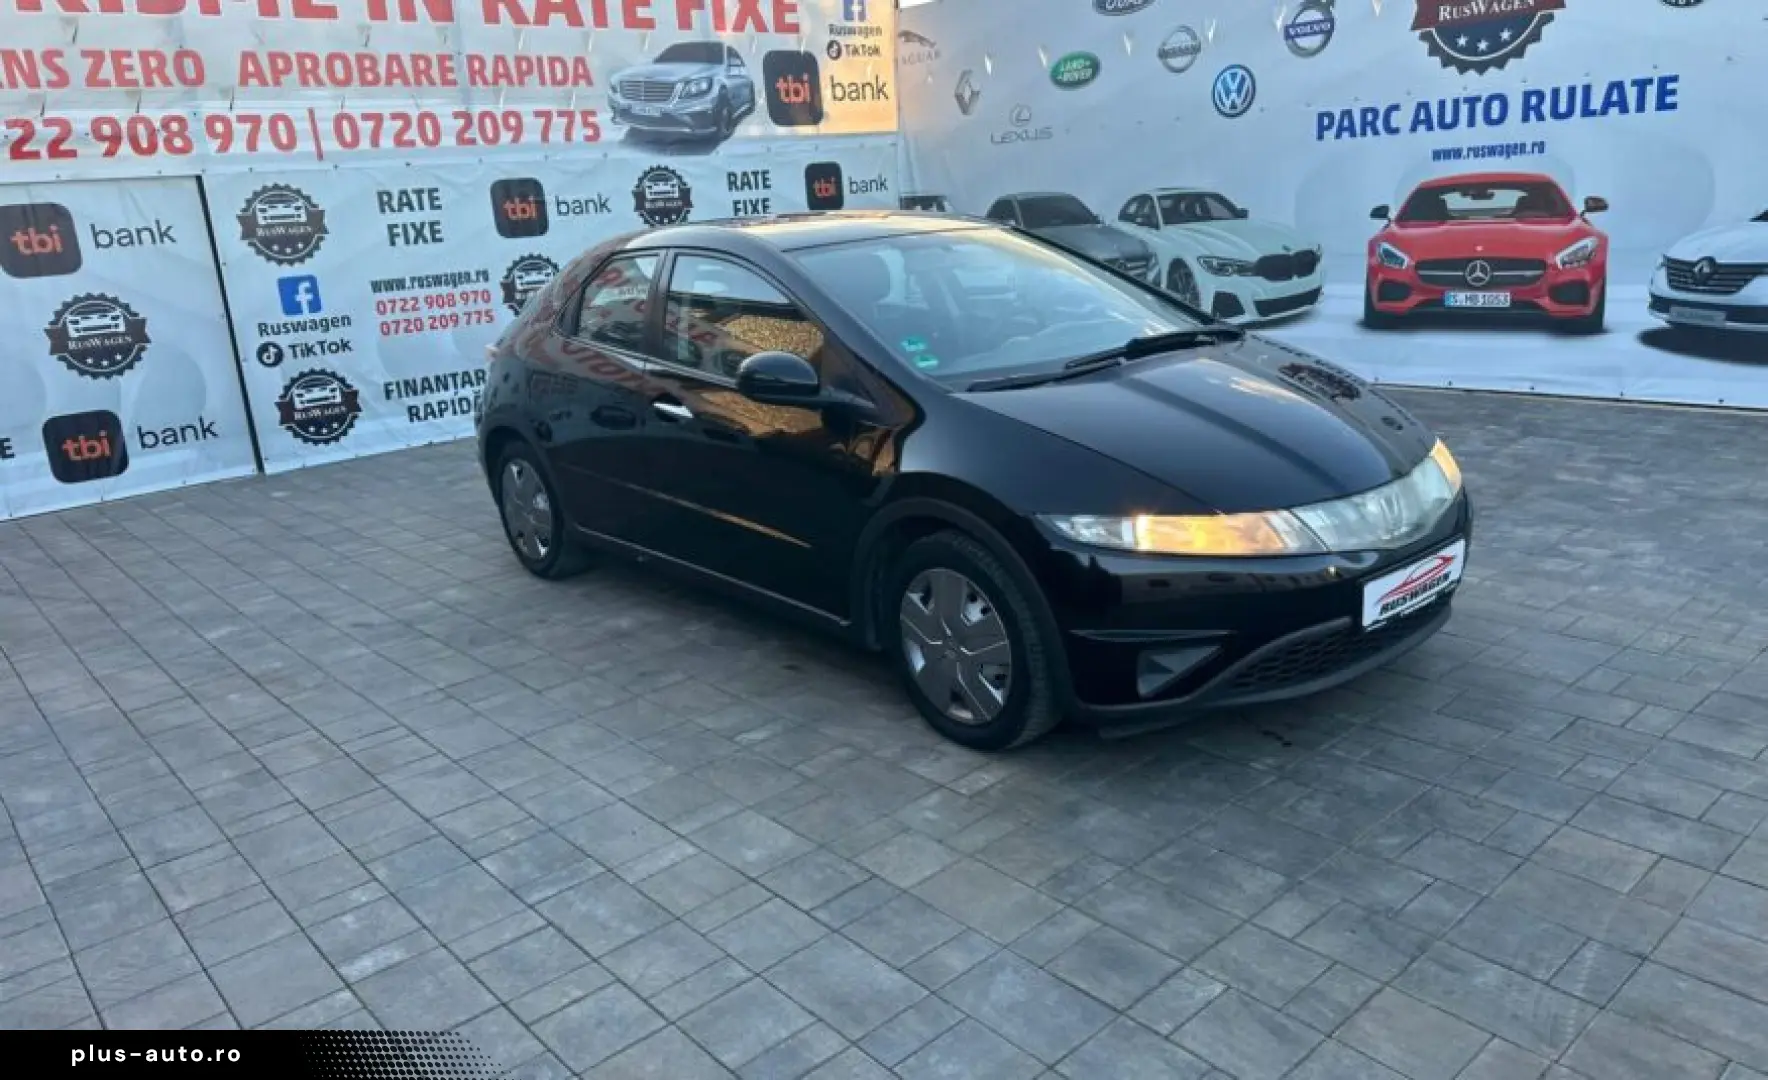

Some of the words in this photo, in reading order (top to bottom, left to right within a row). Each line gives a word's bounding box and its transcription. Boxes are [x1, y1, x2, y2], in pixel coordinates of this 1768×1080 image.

[844, 43, 882, 57] TikTok
[0, 48, 71, 90] NS
[80, 49, 206, 88] ZERO
[238, 51, 457, 88] APROBARE
[466, 54, 594, 88] RAPIDA
[775, 73, 811, 104] tbi
[831, 74, 890, 102] bank
[1316, 103, 1401, 141] PARC
[1409, 91, 1509, 133] AUTO
[1521, 74, 1680, 124] RULATE
[90, 114, 195, 158] 908
[205, 112, 298, 154] 970
[332, 111, 442, 149] 0720
[453, 110, 524, 146] 209
[533, 109, 602, 144] 775
[1431, 139, 1546, 162] www.ruswagen.ro
[727, 169, 772, 193] RATE
[812, 176, 836, 198] tbi
[848, 173, 889, 195] bank
[376, 187, 443, 215] RATE
[502, 195, 539, 221] tbi
[555, 193, 613, 217] bank
[732, 197, 772, 216] FIXE
[10, 224, 64, 256] tbi
[90, 219, 178, 249] bank
[386, 220, 445, 247] FIXE
[370, 269, 490, 292] www.ruswagen.ro
[376, 296, 421, 316] 0722
[424, 291, 457, 310] 908
[460, 288, 492, 306] 970
[257, 314, 352, 337] Ruswagen
[381, 316, 424, 336] 0720
[427, 312, 459, 330] 209
[462, 308, 495, 326] 775
[288, 338, 352, 360] TikTok
[62, 429, 112, 462] tbi
[136, 416, 219, 450] bank
